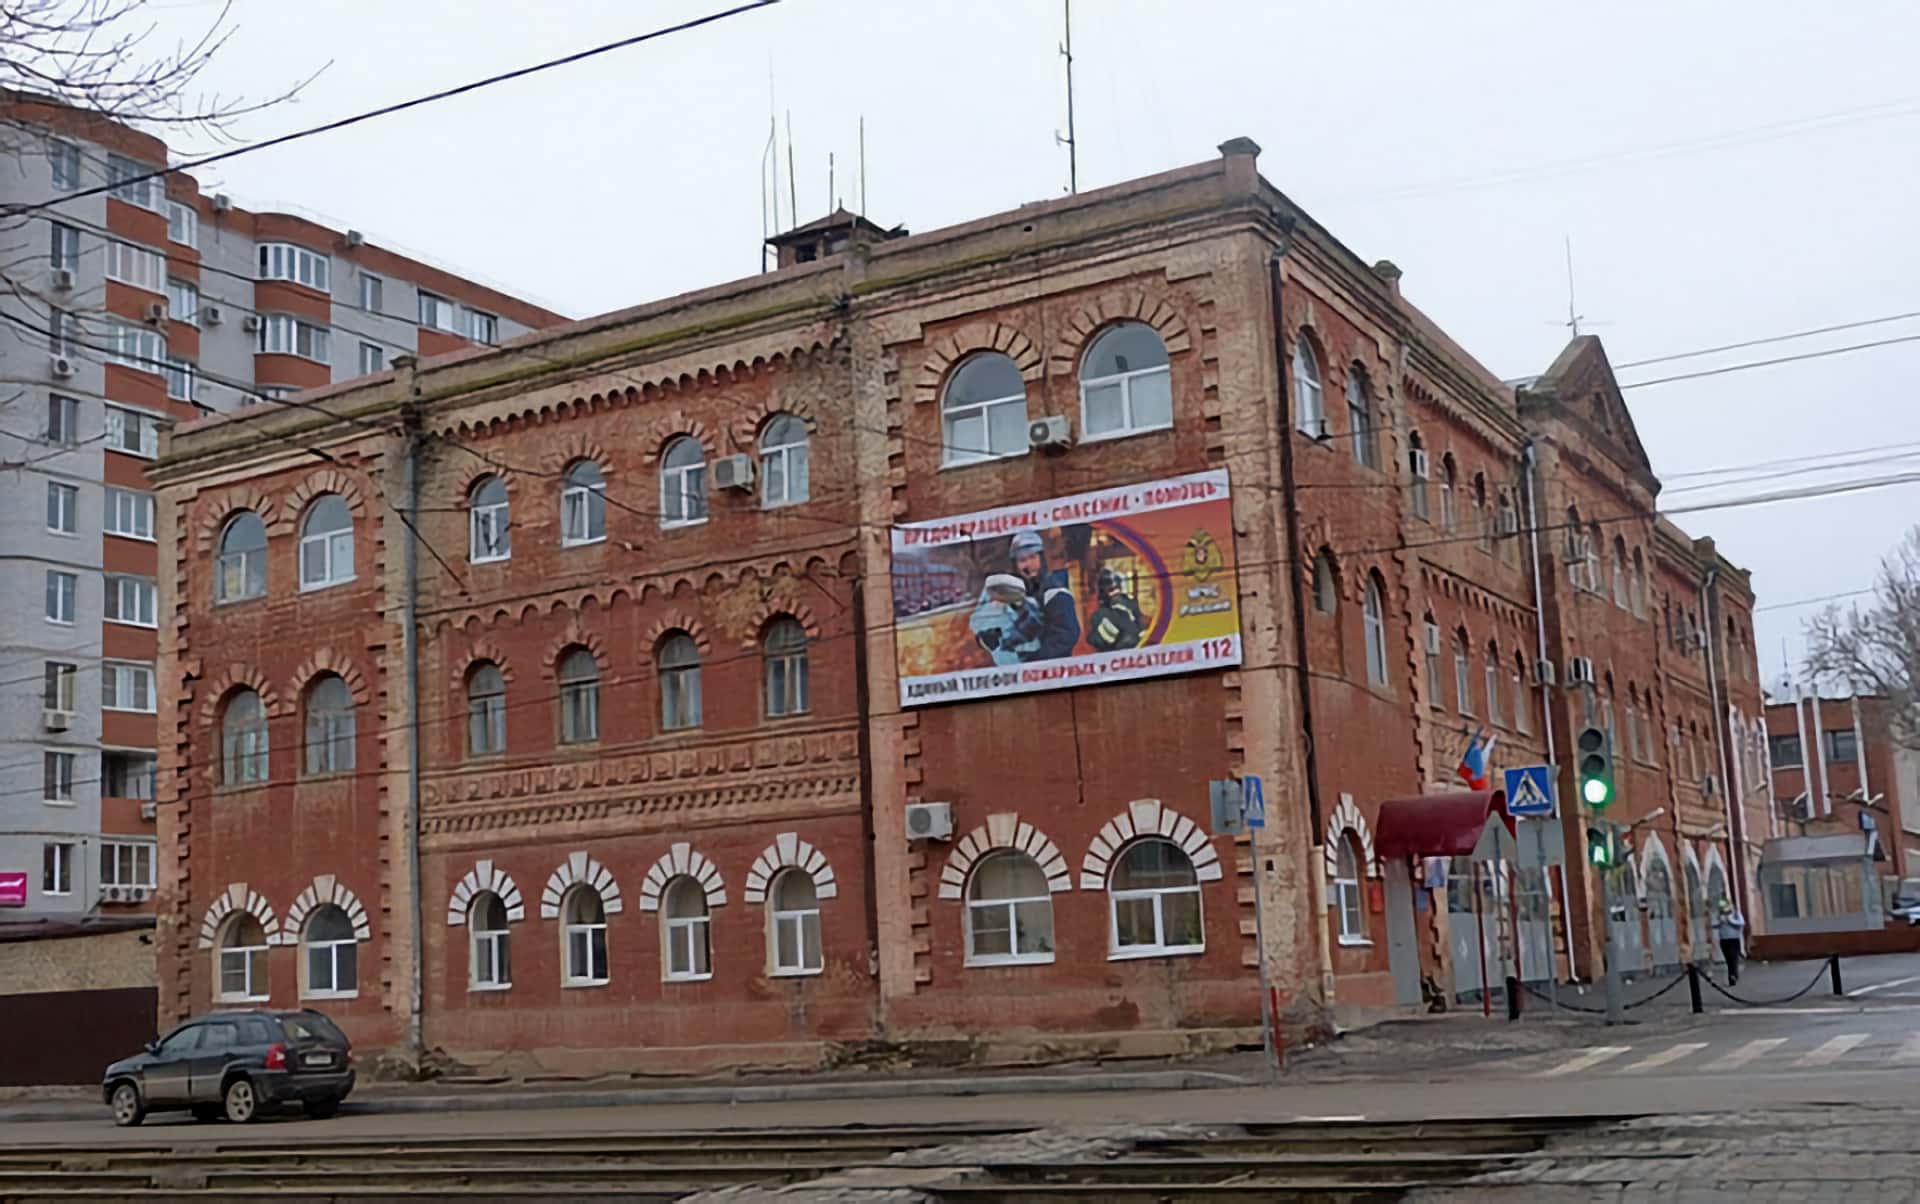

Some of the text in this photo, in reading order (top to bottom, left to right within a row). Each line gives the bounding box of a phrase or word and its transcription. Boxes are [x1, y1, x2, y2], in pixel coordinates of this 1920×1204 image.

[1052, 494, 1129, 521] СПАСЕНИЕ
[1144, 480, 1217, 506] ПОМОЩЬ
[907, 678, 959, 698] ЕДИНЫЙ
[961, 671, 1018, 692] ТЕЛЕФОН
[1022, 661, 1095, 684] ПОЖАРНЫХ
[1110, 648, 1194, 672] СПАСАТЕЛЕЙ
[1202, 637, 1233, 661] 112
